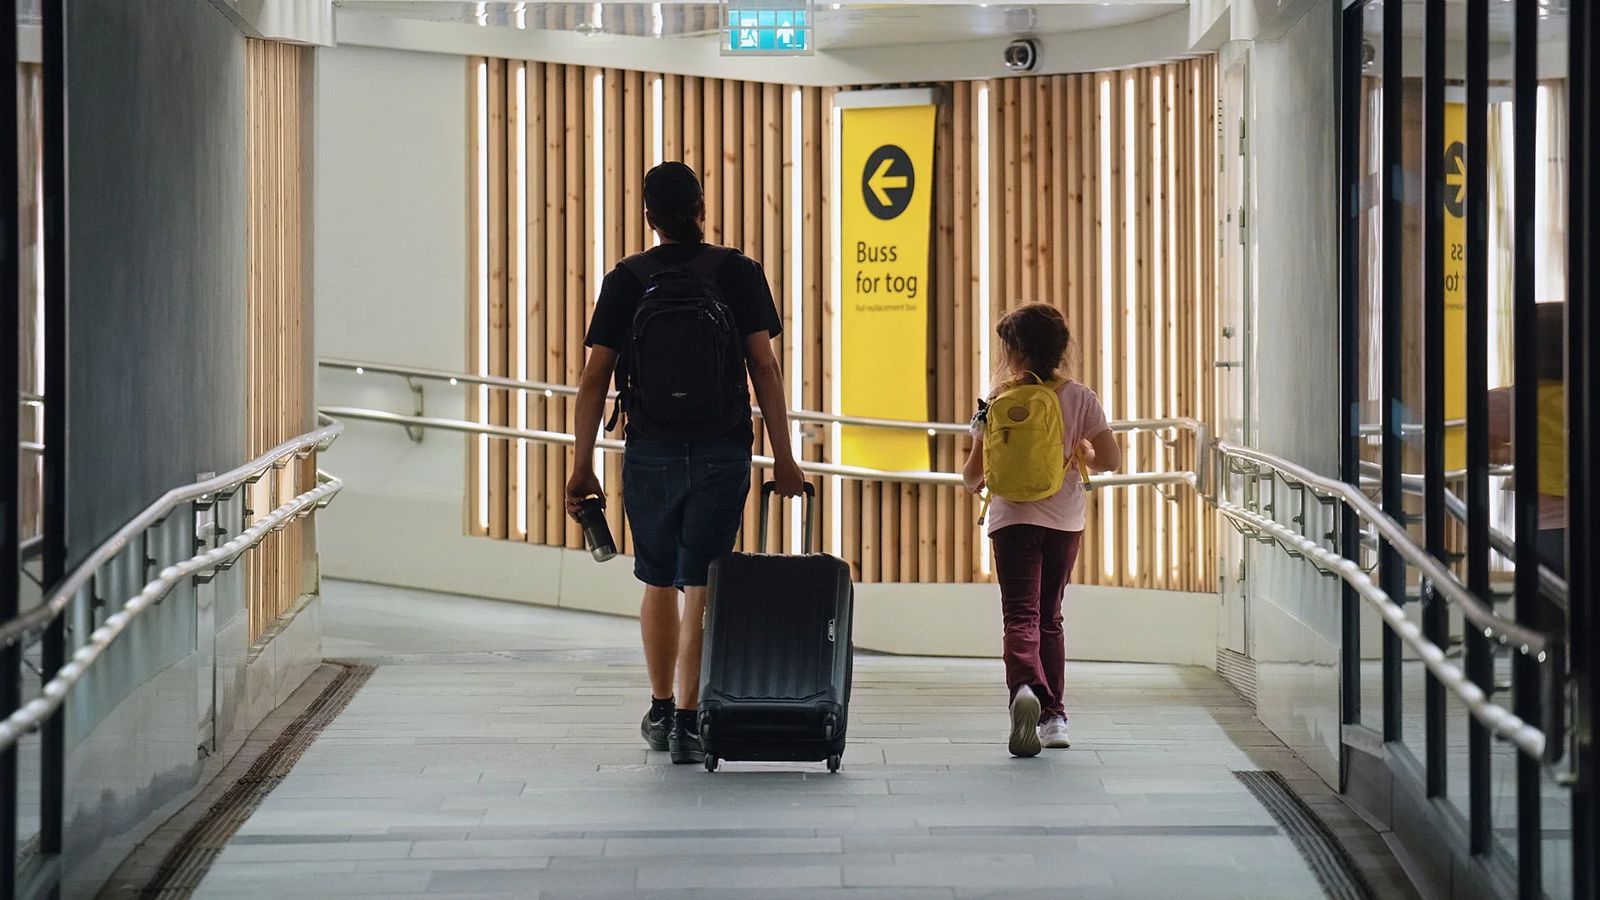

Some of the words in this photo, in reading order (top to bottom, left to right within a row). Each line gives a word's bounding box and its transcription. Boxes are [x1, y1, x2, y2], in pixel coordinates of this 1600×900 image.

[857, 241, 897, 263] Buss
[856, 271, 880, 293] for
[886, 273, 917, 299] tog
